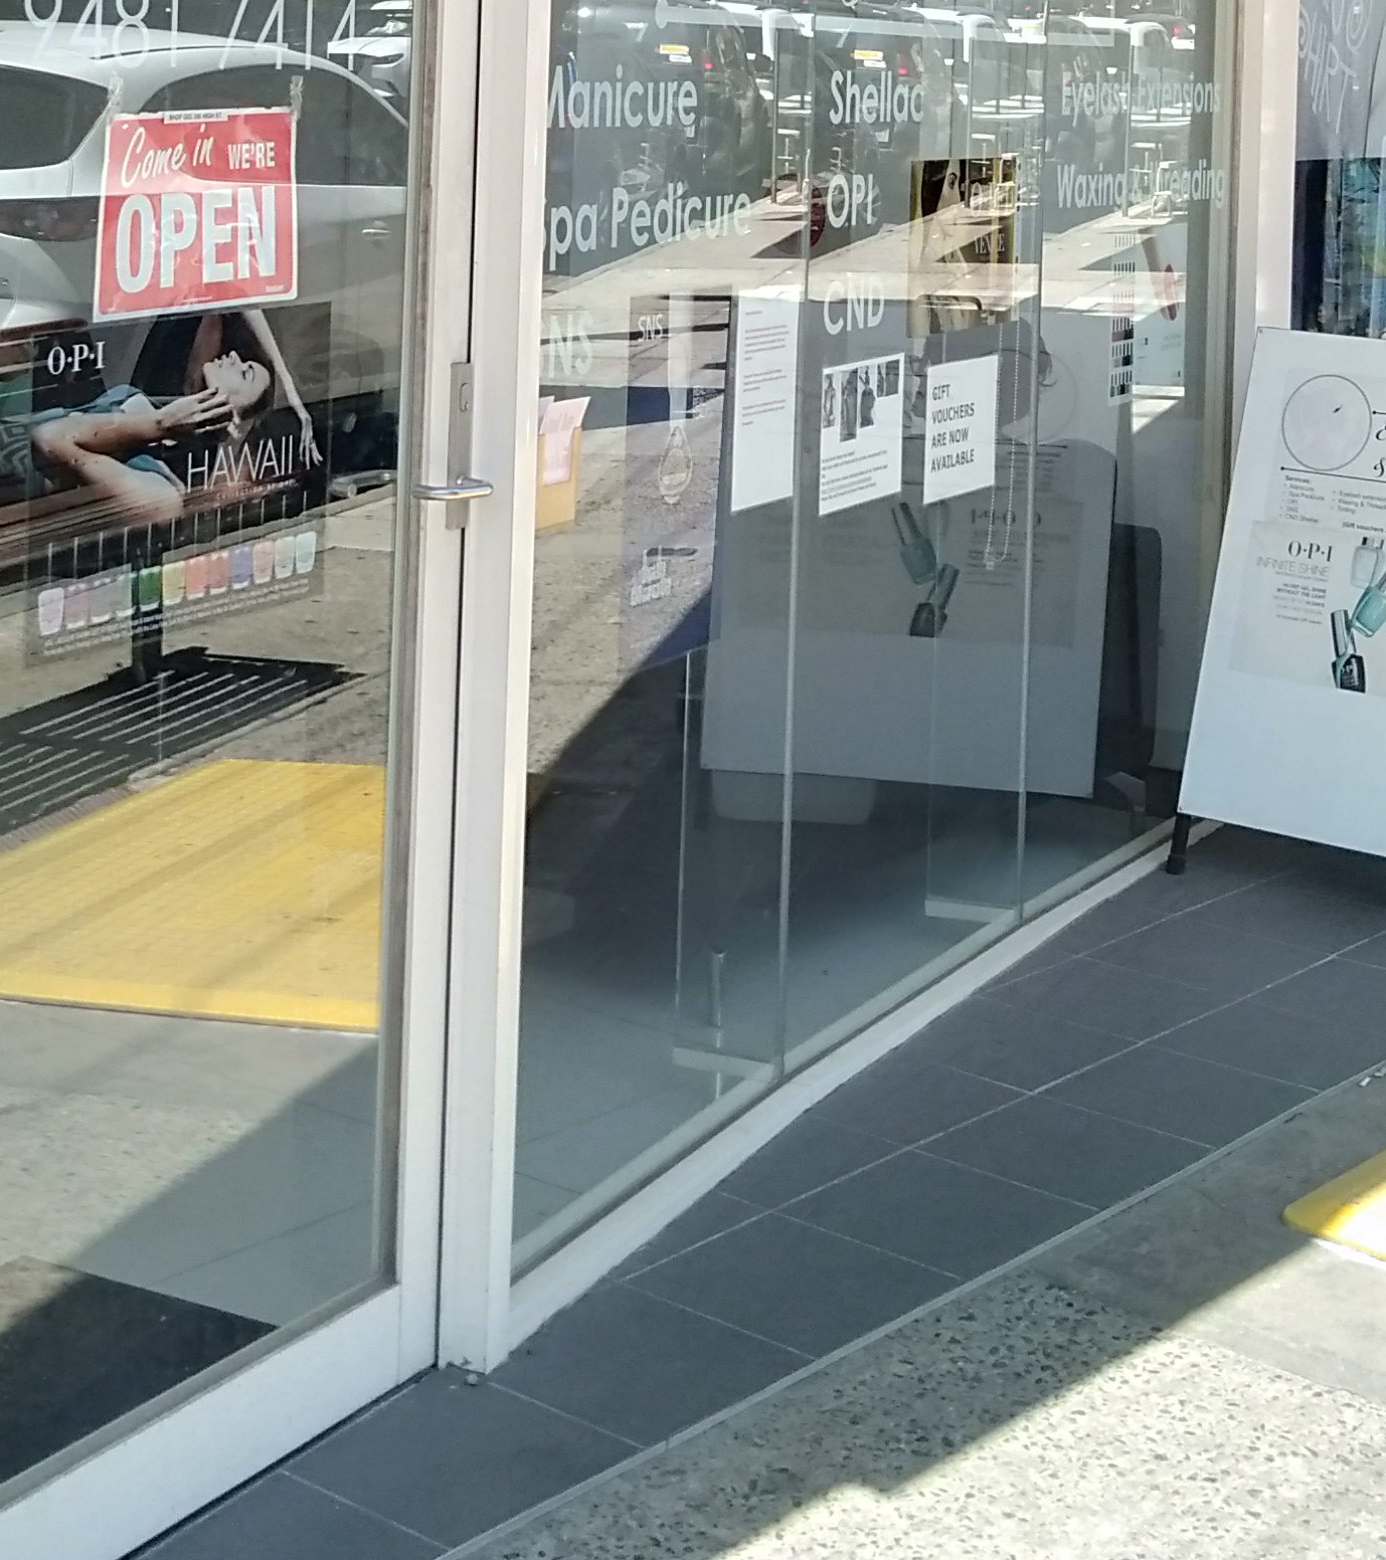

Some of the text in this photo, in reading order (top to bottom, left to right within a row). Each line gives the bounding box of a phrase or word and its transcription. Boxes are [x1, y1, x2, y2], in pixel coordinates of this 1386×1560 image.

[829, 70, 925, 126] Shellac
[1061, 70, 1221, 128] Eyelash Extensions
[121, 123, 276, 189] Come in WE'RE
[826, 173, 873, 229] OPI
[1057, 162, 1127, 213] Waxing
[115, 185, 277, 295] OPEN
[543, 180, 752, 272] pa Pedicure
[637, 313, 664, 342] SNS
[823, 281, 885, 336] CND
[541, 310, 594, 379] NS
[931, 402, 975, 425] VOUCHERS
[932, 383, 951, 401] GIFT
[187, 434, 293, 494] HAWAII
[930, 426, 970, 449] ARE NOW
[930, 448, 975, 474] AVAILABLE
[1256, 556, 1297, 573] INFINITE
[1298, 562, 1329, 577] SHINE
